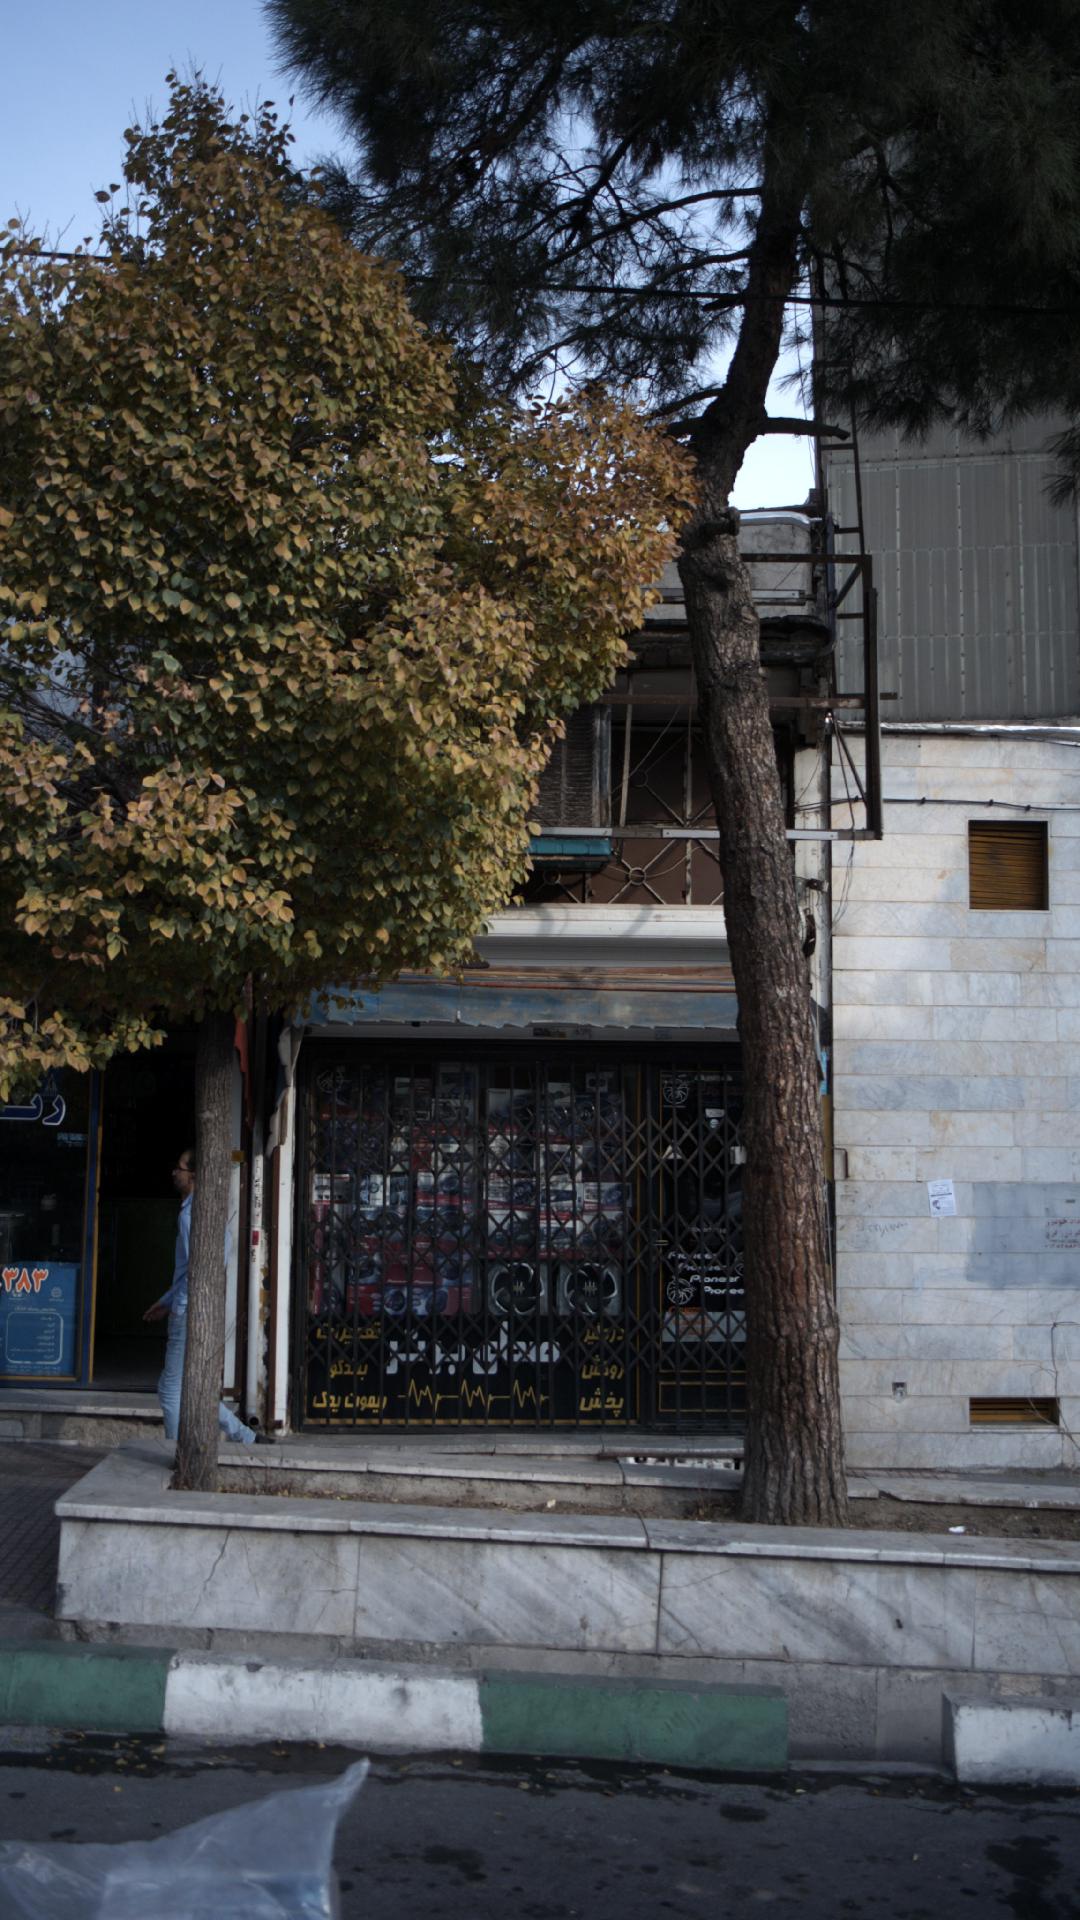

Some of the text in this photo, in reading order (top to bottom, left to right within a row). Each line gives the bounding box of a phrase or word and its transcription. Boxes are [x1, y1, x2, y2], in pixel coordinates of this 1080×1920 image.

[678, 1262, 728, 1271] Pioeer
[690, 1274, 740, 1283] Pioneer
[703, 1286, 745, 1295] Pionee
[579, 1387, 625, 1418] پخش
